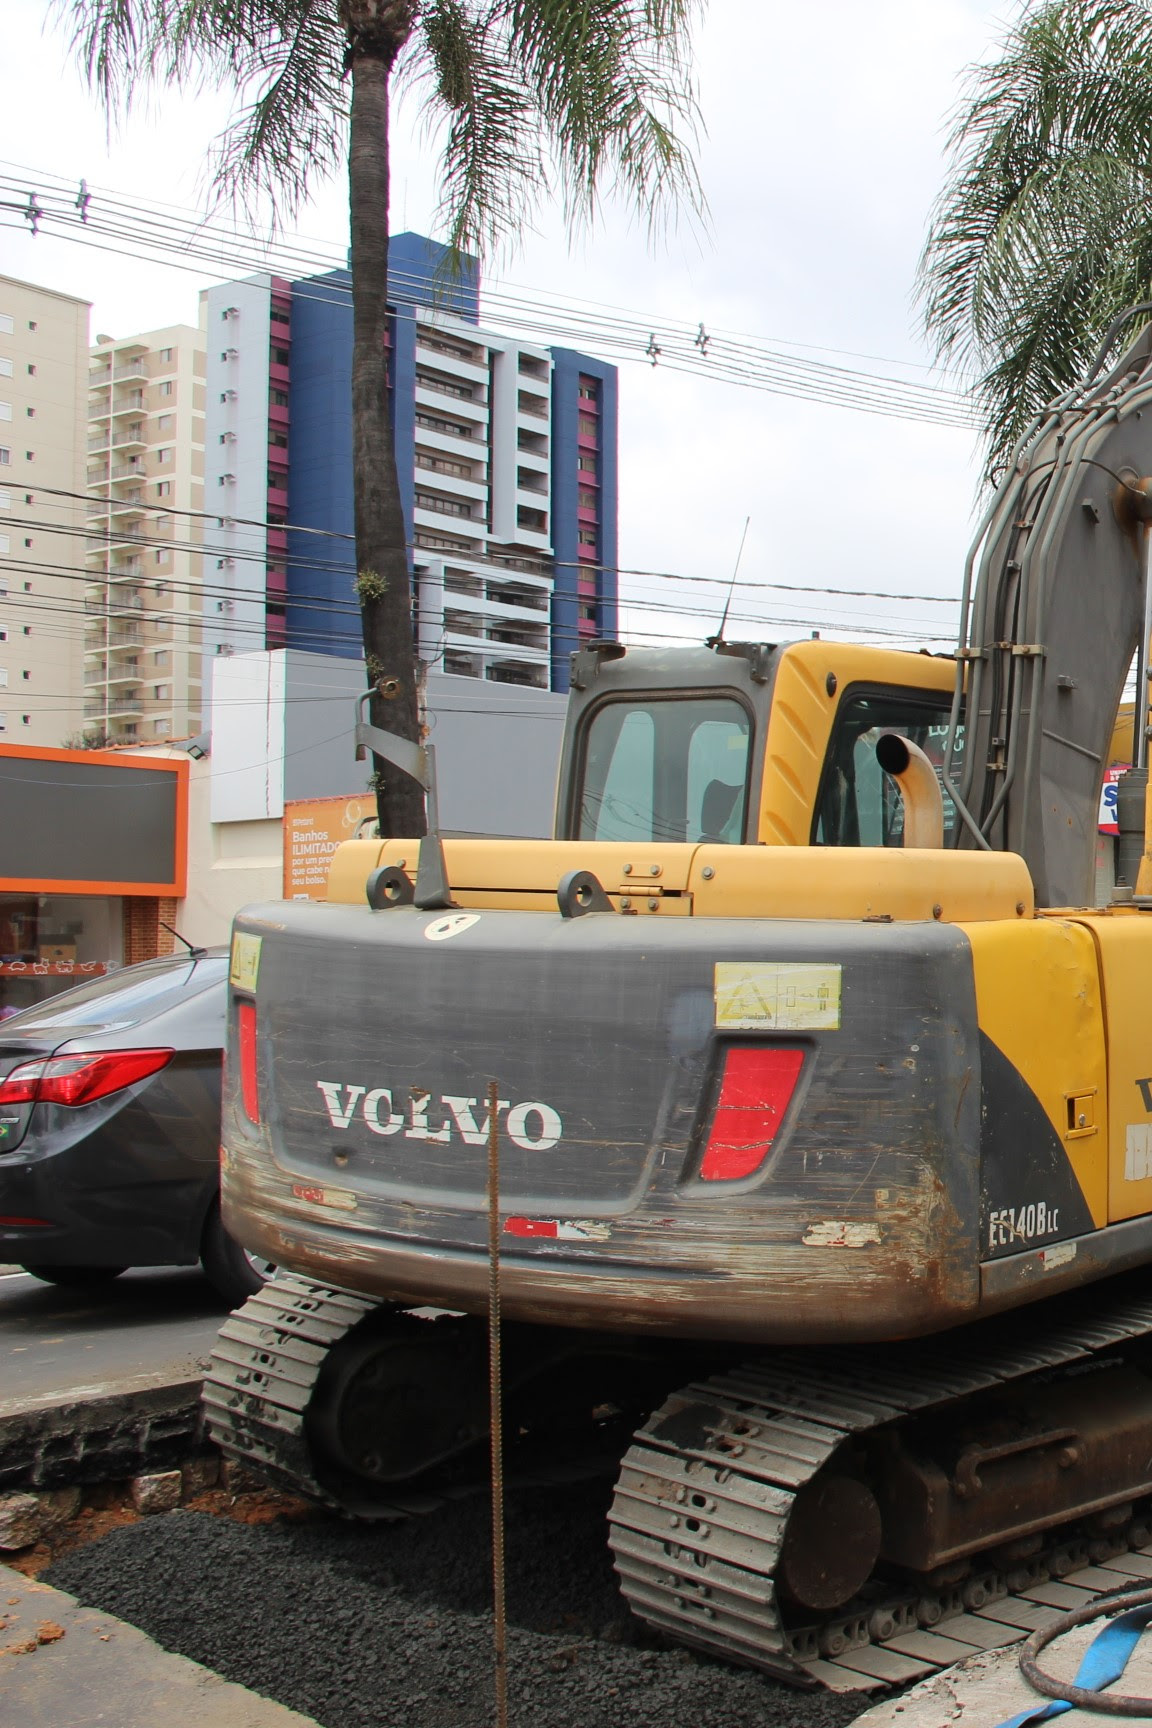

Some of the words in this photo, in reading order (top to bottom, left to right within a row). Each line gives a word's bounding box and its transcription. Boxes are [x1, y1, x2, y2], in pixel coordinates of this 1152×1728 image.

[292, 830, 328, 842] Banhos
[292, 841, 342, 855] ILIMITADO
[292, 858, 304, 867] por
[305, 857, 317, 865] um
[292, 868, 305, 876] que
[306, 865, 323, 875] cabe
[291, 878, 304, 886] seu
[305, 875, 326, 885] bolso.
[316, 1080, 563, 1151] VOLVO
